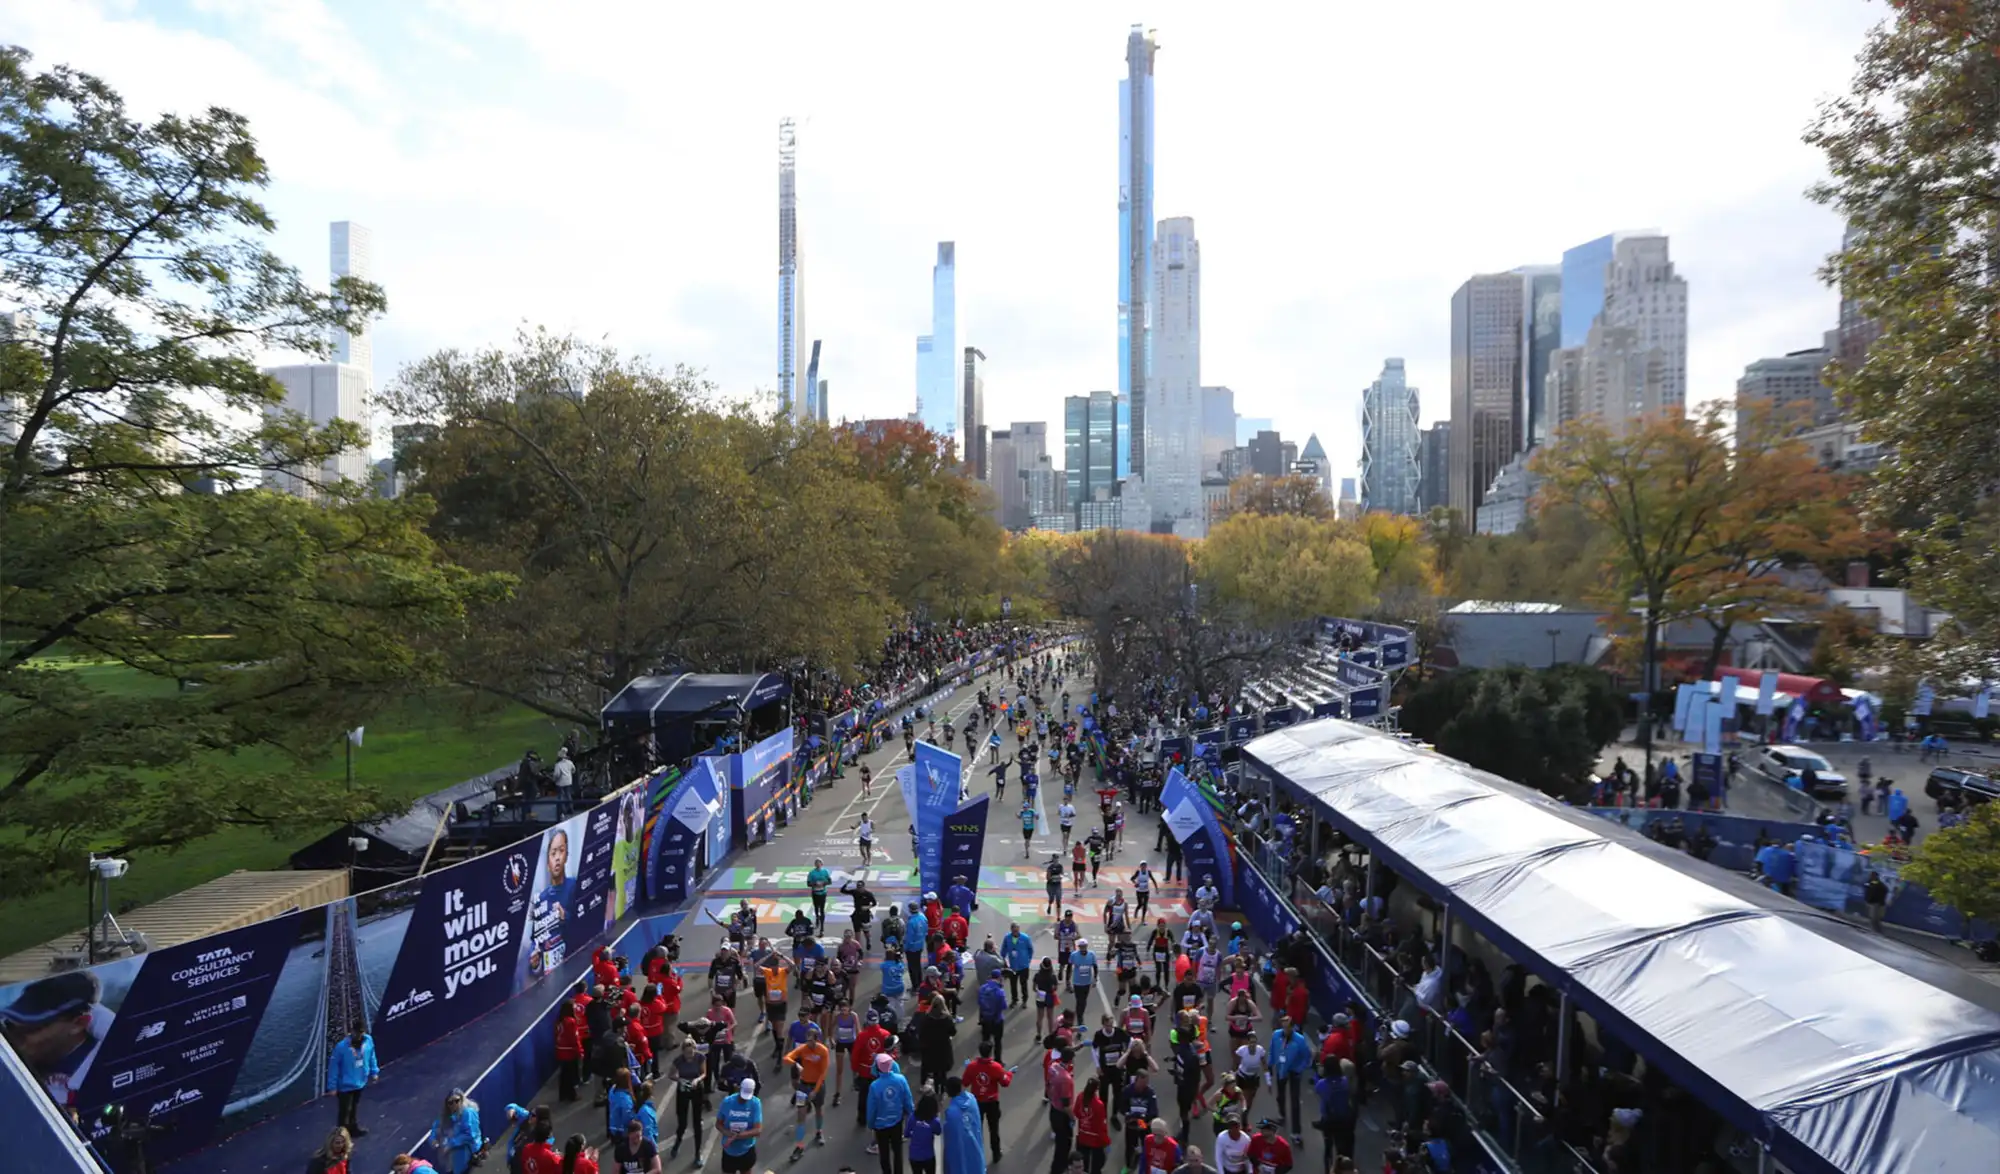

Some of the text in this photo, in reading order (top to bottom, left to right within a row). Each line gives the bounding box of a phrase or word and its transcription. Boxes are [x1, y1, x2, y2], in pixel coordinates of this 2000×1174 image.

[745, 869, 911, 884] FINSH
[444, 888, 464, 916] It
[443, 901, 488, 940] will
[444, 921, 509, 966] move
[196, 946, 232, 963] TATA
[171, 950, 255, 981] CONSULTANCY
[187, 965, 240, 988] SERVICES
[444, 956, 497, 999] you.
[183, 1006, 231, 1025] AIRLINES
[192, 1001, 231, 1017] UNITED
[181, 1048, 198, 1059] THE
[190, 1049, 218, 1062] FAMILY
[90, 1125, 113, 1140] TAT
